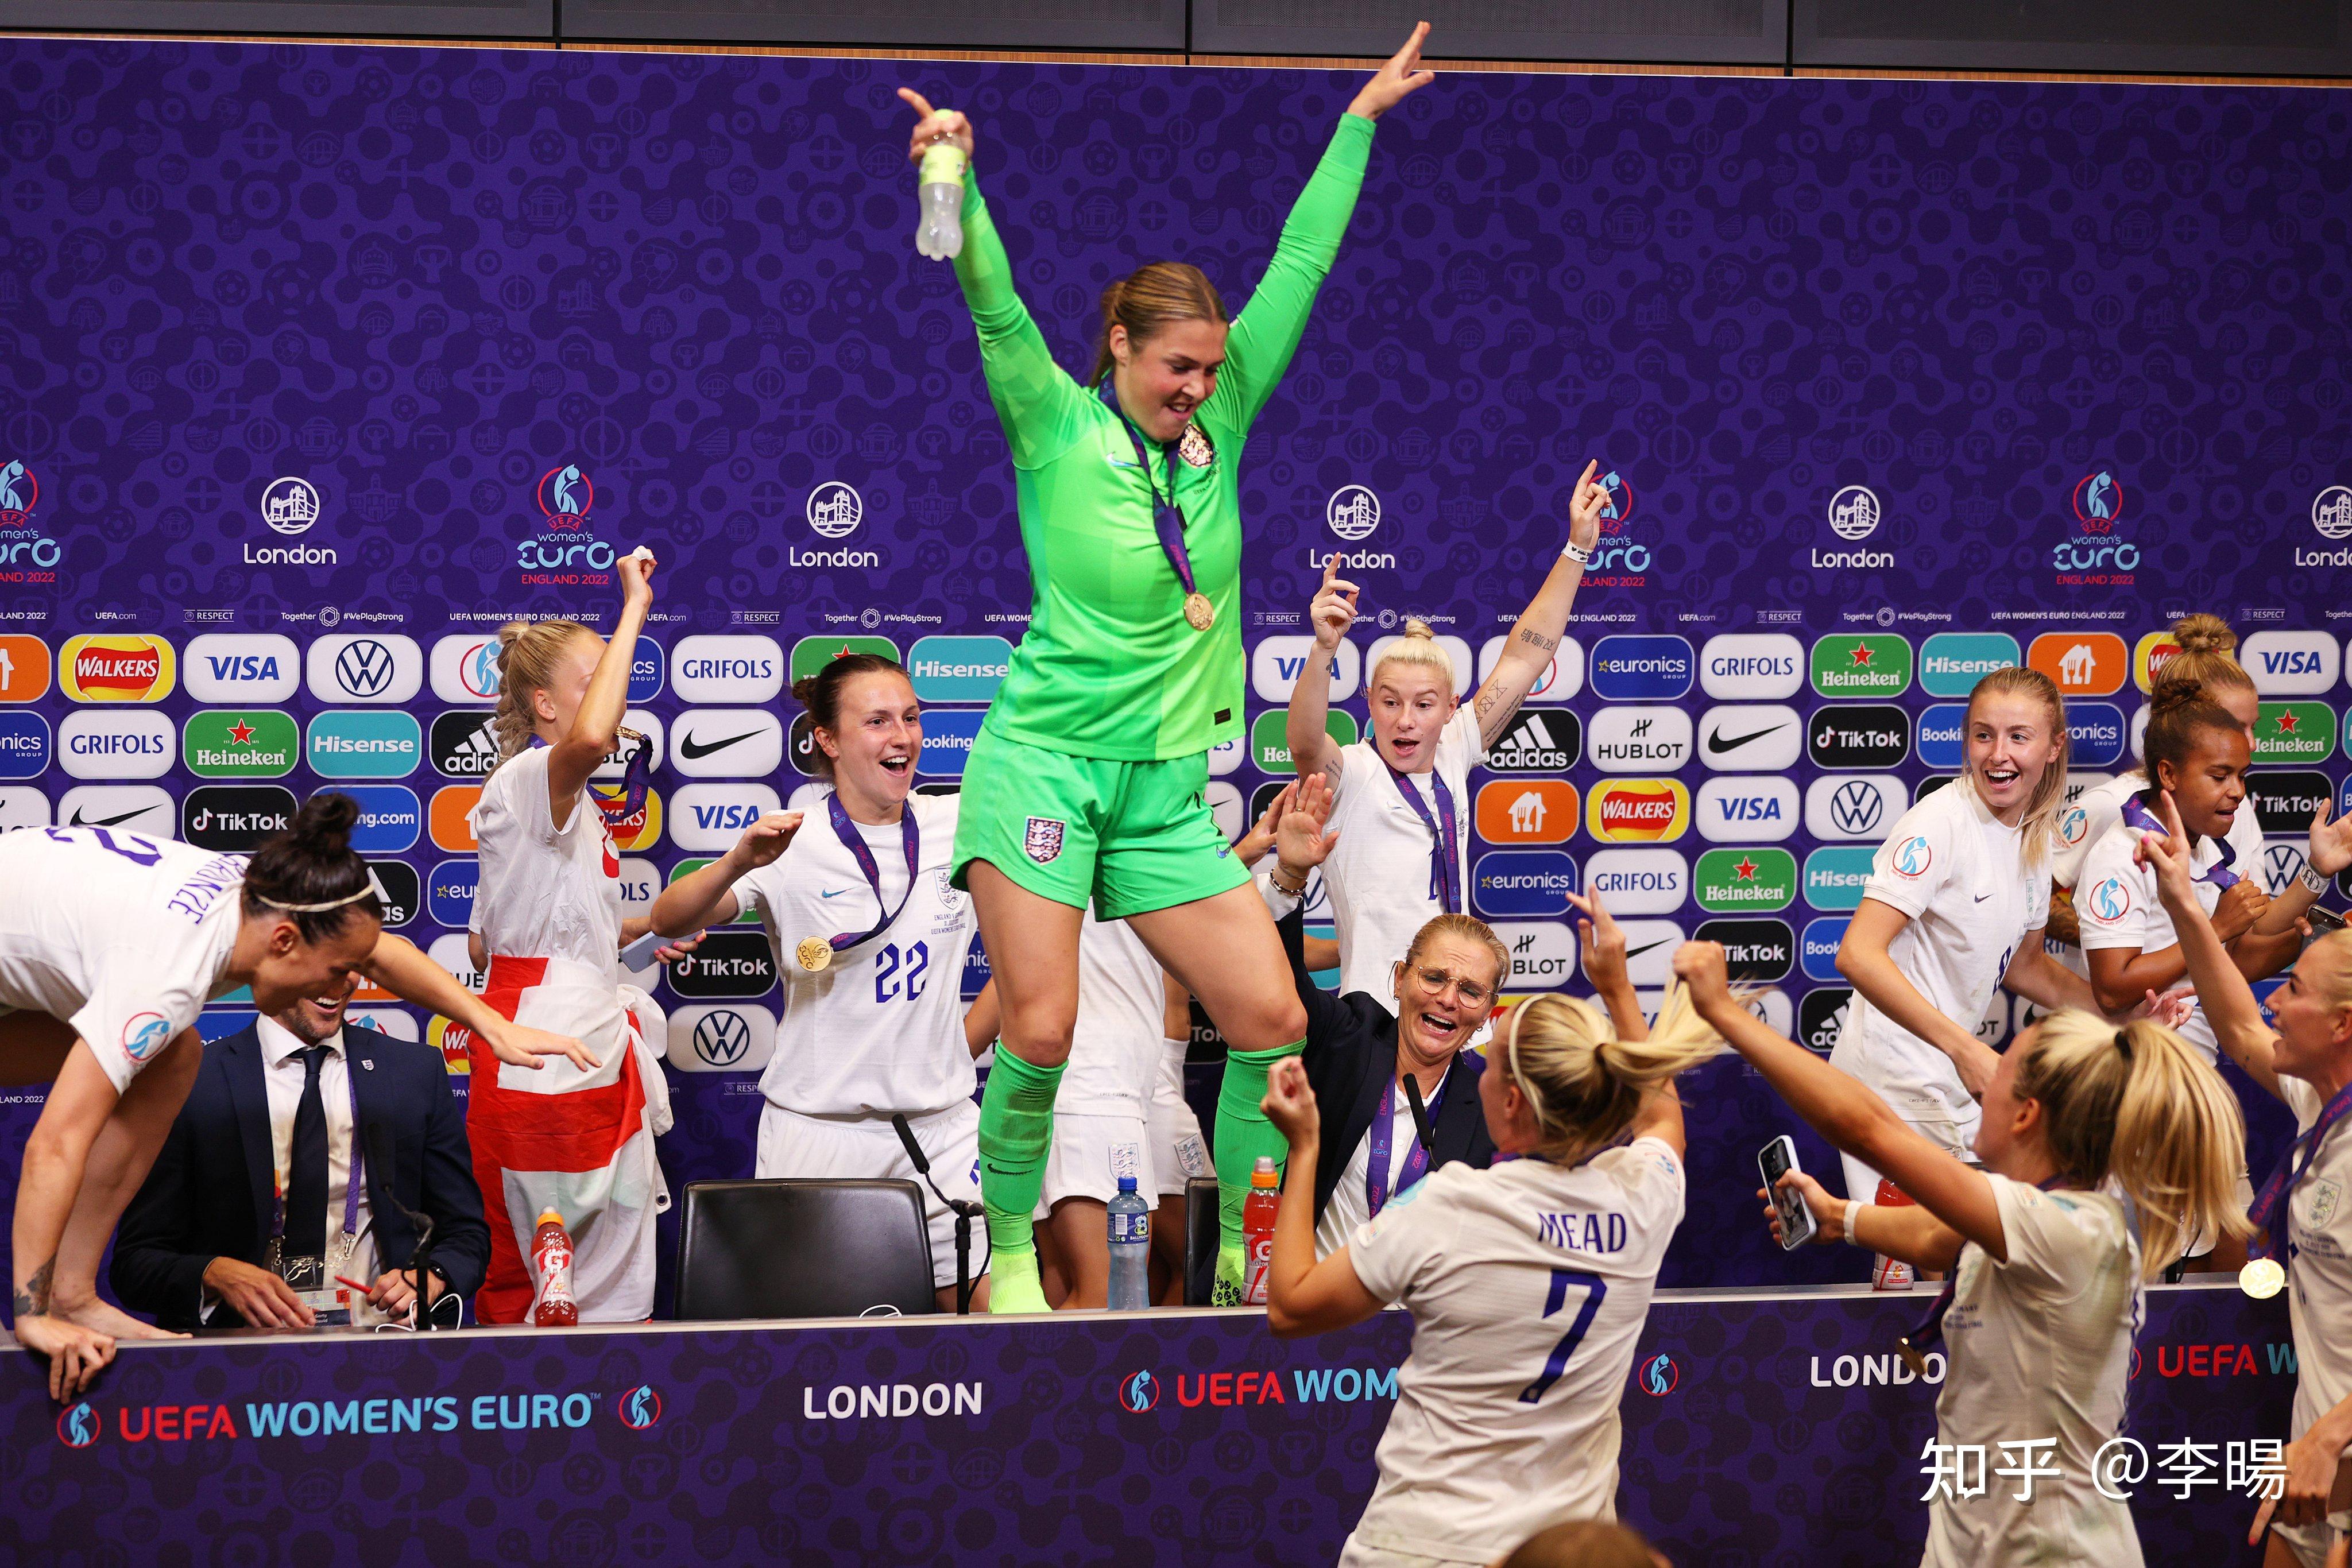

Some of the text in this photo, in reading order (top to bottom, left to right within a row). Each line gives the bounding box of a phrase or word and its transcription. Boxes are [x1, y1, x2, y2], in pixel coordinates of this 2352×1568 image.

[0, 528, 39, 539] men's
[537, 531, 593, 543] women's
[1598, 535, 1631, 546] men's
[2071, 535, 2121, 545] women's
[244, 543, 336, 564] London
[790, 546, 878, 567] London
[1310, 549, 1395, 569] London
[1812, 548, 1894, 568] London
[26, 572, 55, 582] 2022
[521, 575, 609, 584] ENGLAND 2022
[1579, 576, 1645, 586] GLAND 2022
[2056, 575, 2134, 584] ENGLAND 2022
[0, 612, 47, 620] LAND 2022
[95, 612, 137, 620] UEFA.com
[197, 611, 234, 621] RESPECT
[281, 611, 404, 622] Together #WePlayStrong
[450, 613, 600, 621] UEFA WOMEN'S EURO ENGLAND 2022
[647, 614, 686, 622] UEFA.com
[744, 613, 780, 622] RESPECT
[825, 613, 942, 624] Together #WePlayStrong
[1266, 614, 1300, 622] RESPECT
[1352, 614, 1376, 624] gether
[1498, 614, 1518, 622] UEFA
[1768, 613, 1801, 622] RESPECT
[1843, 612, 1951, 622] Together #WePlayStrong
[2012, 611, 2048, 620] WOMEN'S
[2049, 612, 2069, 620] EURO
[2071, 612, 2107, 620] ENGLAND
[2108, 612, 2125, 620] 2022
[2253, 611, 2285, 619] RESPECT
[2325, 610, 2352, 620] Togethe
[77, 656, 157, 679] WALKERS
[204, 656, 279, 681] VISA
[683, 659, 772, 679] GRIFOLS
[914, 660, 1009, 677] Hisense
[1609, 657, 1686, 674] euronics
[1711, 657, 1793, 676] GRIFOLS
[1925, 656, 2013, 673] Hisense
[2258, 652, 2322, 675] VISA
[1821, 669, 1900, 687] Heineken
[71, 734, 164, 754] GRIFOLS
[314, 736, 413, 753] Hisense
[922, 734, 973, 752] ooking
[1838, 729, 1901, 748] TikTok
[197, 748, 286, 765] Heineken
[1491, 749, 1567, 768] adidas
[1598, 744, 1683, 760] HUBLOT
[445, 752, 498, 772] adid
[1603, 799, 1673, 819] WALKERS
[1715, 797, 1781, 820] VISA
[2263, 795, 2324, 813] TikTok
[216, 812, 288, 831] TikTok
[357, 814, 415, 828] ng.com
[689, 805, 760, 829] VISA
[1492, 871, 1569, 889] euronics
[1595, 872, 1677, 892] GRIFOLS
[1705, 884, 1784, 901] Heineken
[1723, 944, 1785, 962] TikTok
[699, 958, 768, 977] TikTok
[876, 939, 928, 1003] 22
[1513, 959, 1566, 975] BLOT
[737, 1085, 758, 1093] RESP
[1537, 1212, 1627, 1253] MEAD
[1517, 1269, 1607, 1404] 7
[2158, 1344, 2258, 1377] UEFA
[1811, 1352, 1947, 1388] LONDO
[1177, 1371, 1285, 1407] UEFA
[804, 1382, 982, 1420] LONDON
[119, 1393, 592, 1442] UEFA WOMEN'S EURO
